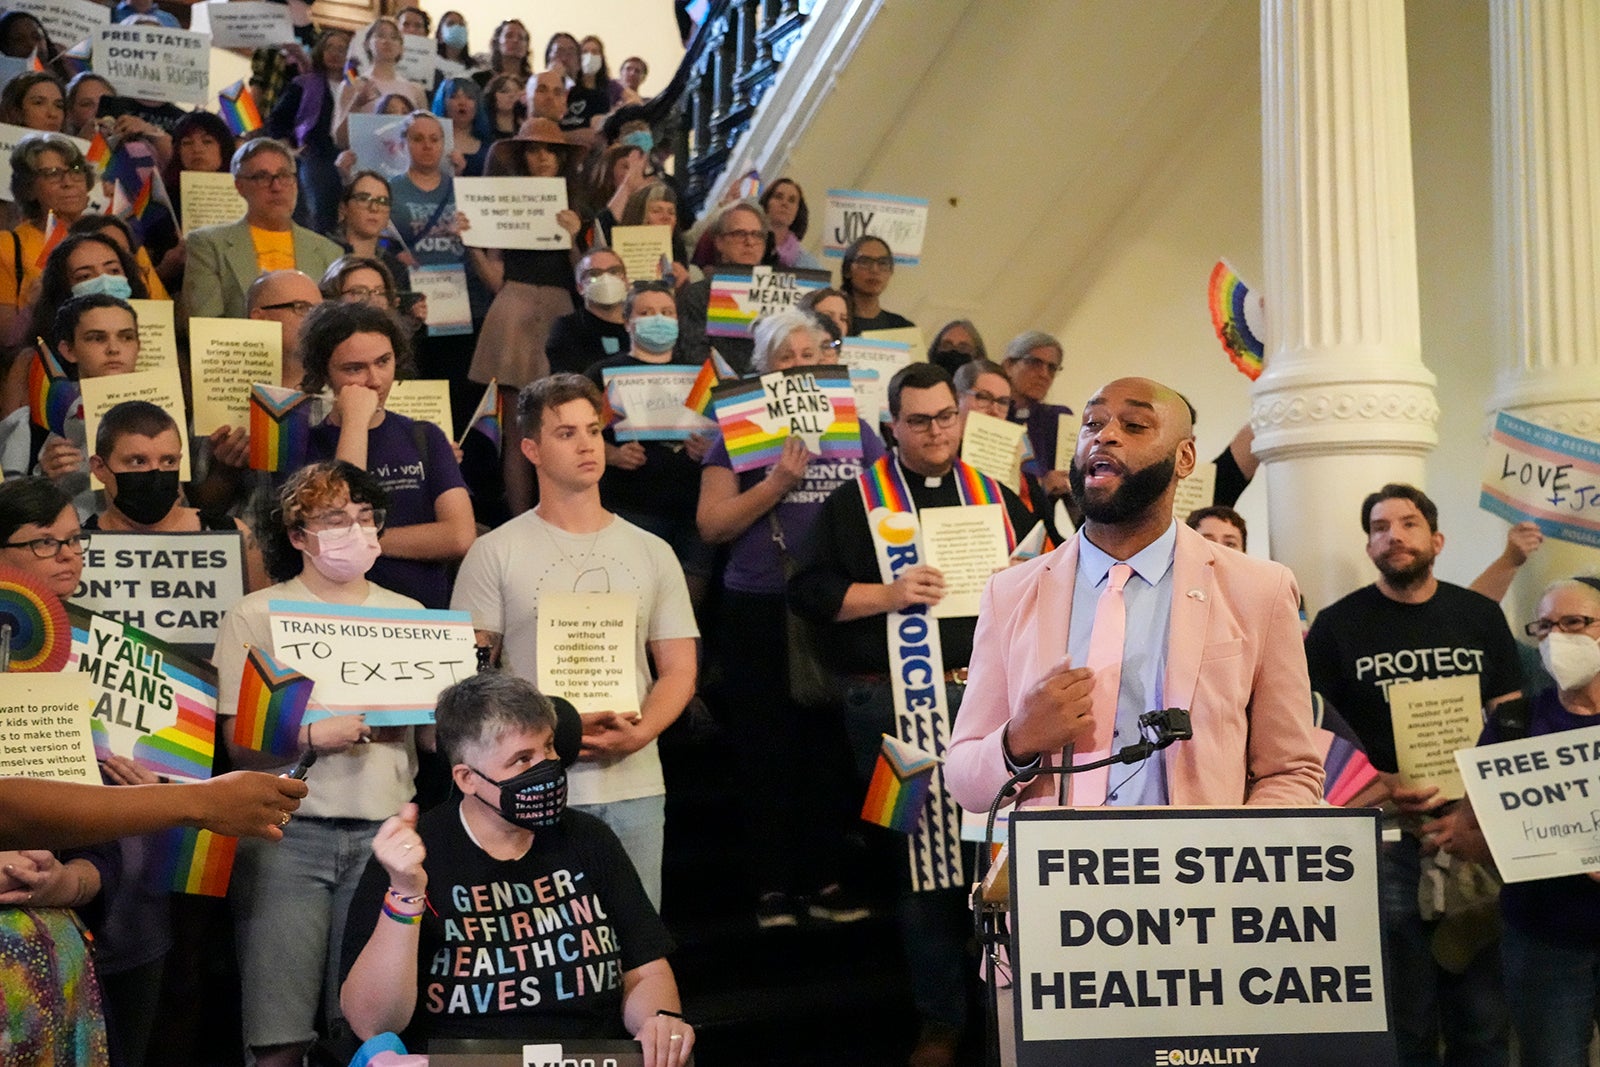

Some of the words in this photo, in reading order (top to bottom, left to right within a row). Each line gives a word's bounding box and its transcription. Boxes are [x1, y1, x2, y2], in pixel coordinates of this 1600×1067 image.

[102, 31, 140, 42] FREE
[146, 33, 201, 48] STATES
[109, 47, 158, 60] DON'T
[834, 210, 874, 245] JOY
[755, 272, 797, 290] Y'ALL
[749, 288, 802, 306] MEANS
[206, 349, 230, 357] bring
[140, 387, 158, 395] NOT
[766, 375, 820, 398] Y'ALL
[766, 394, 829, 420] MEANS
[790, 414, 823, 434] ALL
[1500, 453, 1573, 491] LOVE
[115, 550, 227, 569] STATES
[71, 580, 141, 598] ON'T
[151, 580, 216, 598] BAN
[155, 610, 226, 628] CAR
[550, 619, 555, 627] I
[558, 619, 579, 627] love
[600, 619, 624, 627] child
[280, 620, 337, 636] TRANS
[340, 625, 378, 639] KIDS
[381, 627, 452, 640] DESERVE
[567, 631, 606, 639] without
[94, 628, 167, 681] Y'ALL
[281, 641, 332, 660] TO
[553, 643, 605, 651] conditions
[556, 655, 608, 665] judgment.
[1356, 647, 1484, 680] PROTECT
[341, 660, 463, 686] EXIST
[550, 668, 602, 676] encourage
[605, 668, 623, 676] you
[79, 652, 174, 711] MEANS
[41, 702, 79, 714] provide
[1440, 696, 1464, 706] proud
[7, 718, 28, 727] kids
[31, 717, 54, 726] with
[57, 716, 74, 725] the
[92, 691, 151, 734] ALL
[1411, 710, 1441, 718] mother
[1408, 720, 1443, 729] amazing
[1445, 717, 1469, 726] young
[24, 730, 52, 739] make
[54, 729, 81, 738] them
[4, 745, 27, 754] best
[30, 743, 68, 752] version
[71, 741, 81, 749] of
[46, 754, 86, 764] without
[1477, 751, 1550, 780] FREE
[57, 767, 86, 777] being
[1499, 779, 1589, 811] DON'T
[1522, 820, 1592, 842] Human
[1038, 848, 1160, 886] FREE
[1174, 845, 1355, 885] STATES
[451, 869, 585, 913] GENDER-
[1060, 907, 1216, 947] DON'T
[1232, 905, 1336, 944] BAN
[425, 976, 541, 1014] SAVES
[554, 958, 622, 1001] LIVE
[1031, 968, 1224, 1010] HEALTH
[1239, 965, 1373, 1005] CARE
[1155, 1047, 1260, 1066] EQUALITY
